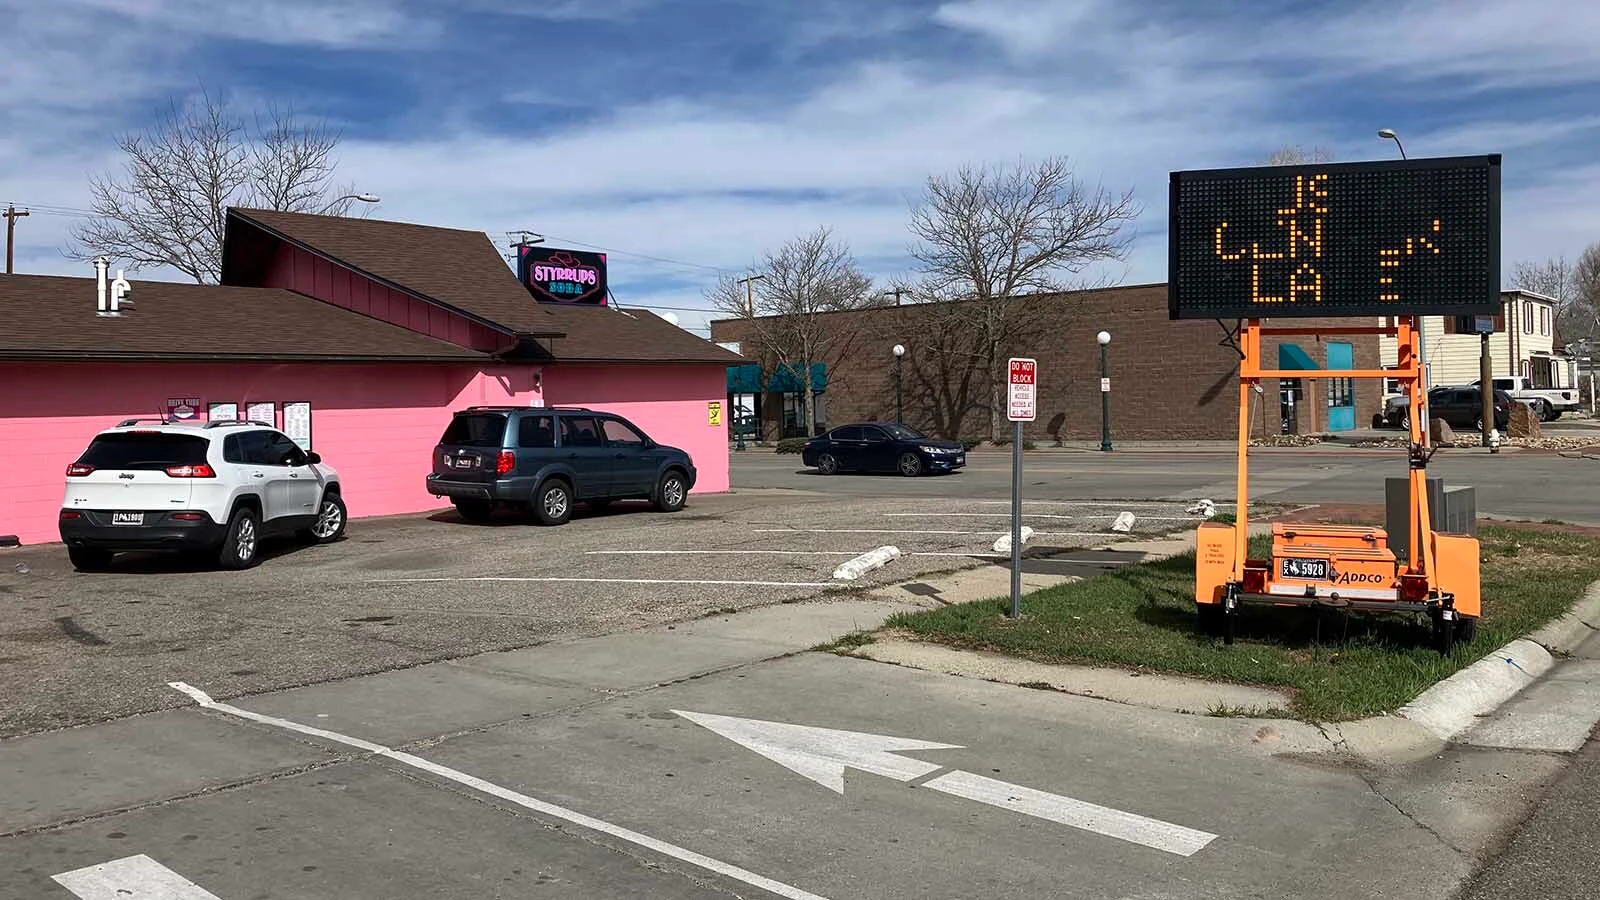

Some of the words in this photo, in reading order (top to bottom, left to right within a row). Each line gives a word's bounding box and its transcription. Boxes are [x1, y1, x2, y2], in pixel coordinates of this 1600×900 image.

[534, 265, 596, 286] STYRRUPS
[549, 282, 583, 294] SODA
[1011, 362, 1020, 371] DO
[1021, 362, 1034, 371] NOT
[1012, 374, 1032, 383] BLOCK
[118, 472, 135, 480] Jeep
[1302, 563, 1324, 576] 5928
[1338, 571, 1382, 585] ADDCO
